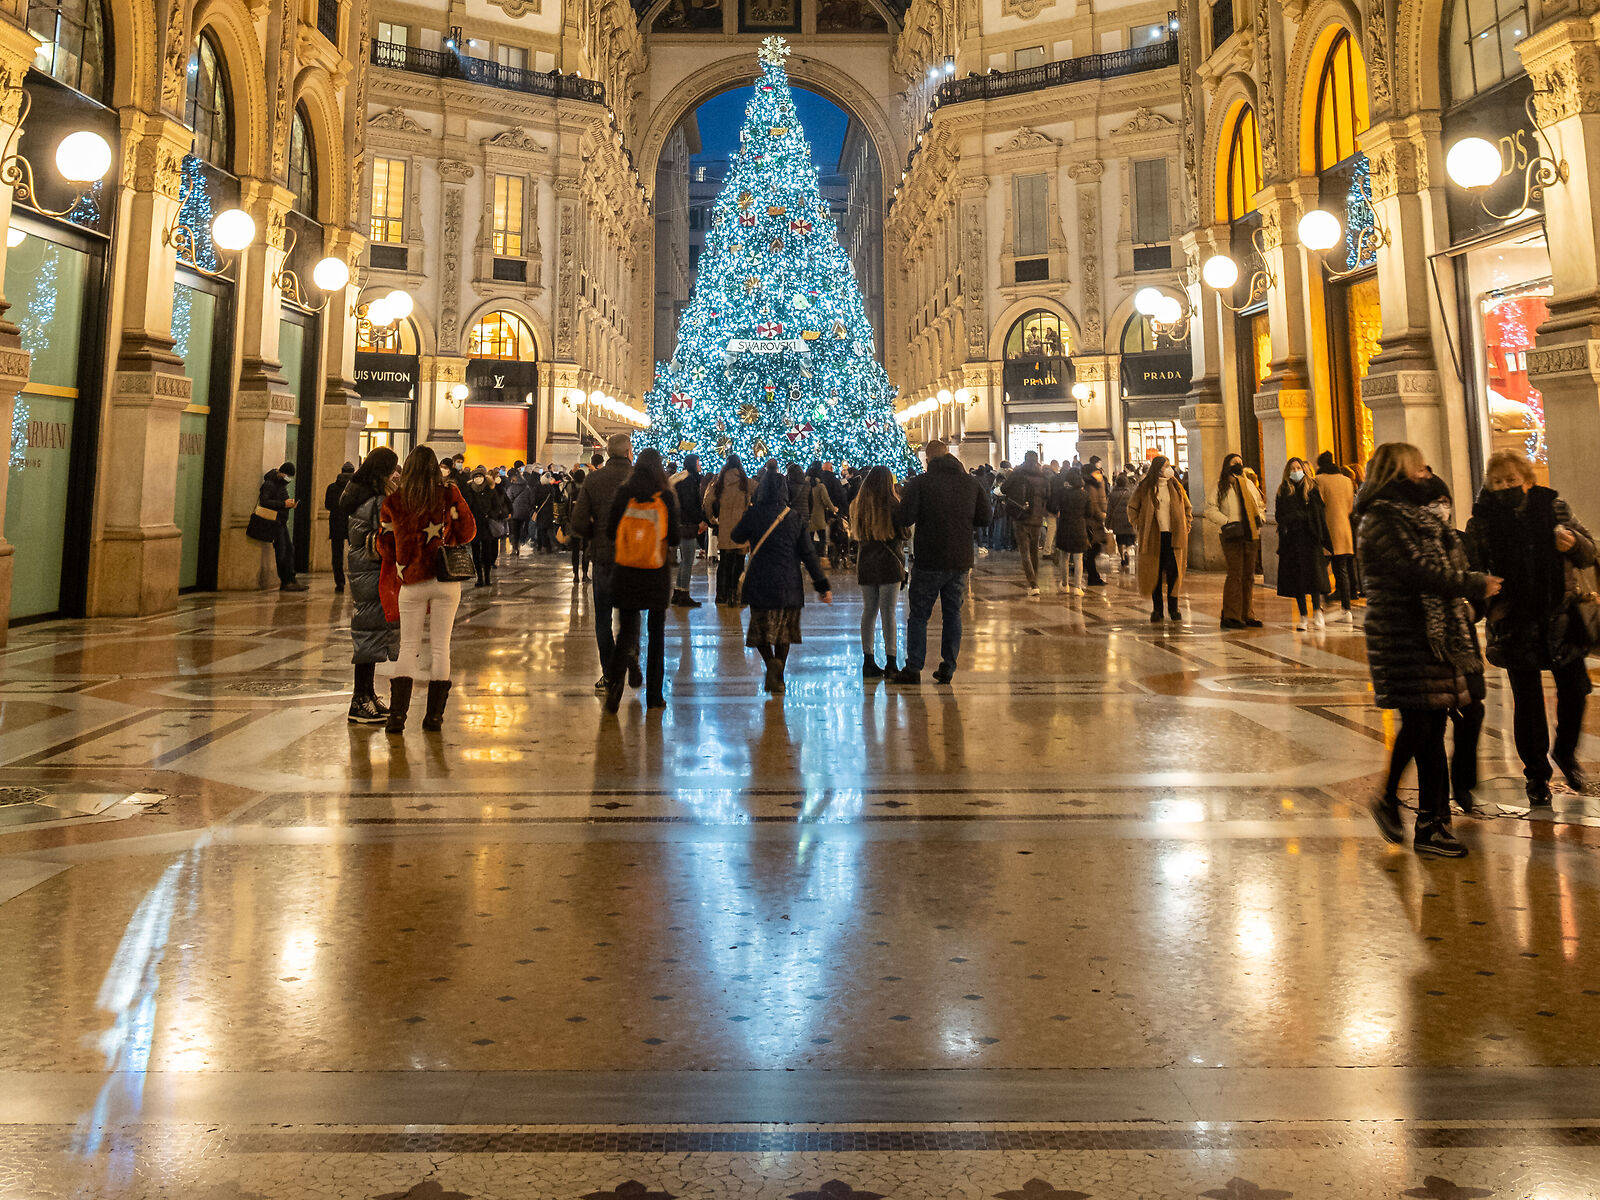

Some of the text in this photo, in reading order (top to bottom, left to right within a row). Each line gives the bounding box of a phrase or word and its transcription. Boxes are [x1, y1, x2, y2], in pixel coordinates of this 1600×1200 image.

[737, 341, 797, 352] SWAROVSKI
[352, 370, 411, 383] UIS VUITTON
[1143, 371, 1183, 381] PRADA
[1023, 377, 1058, 387] PRADA
